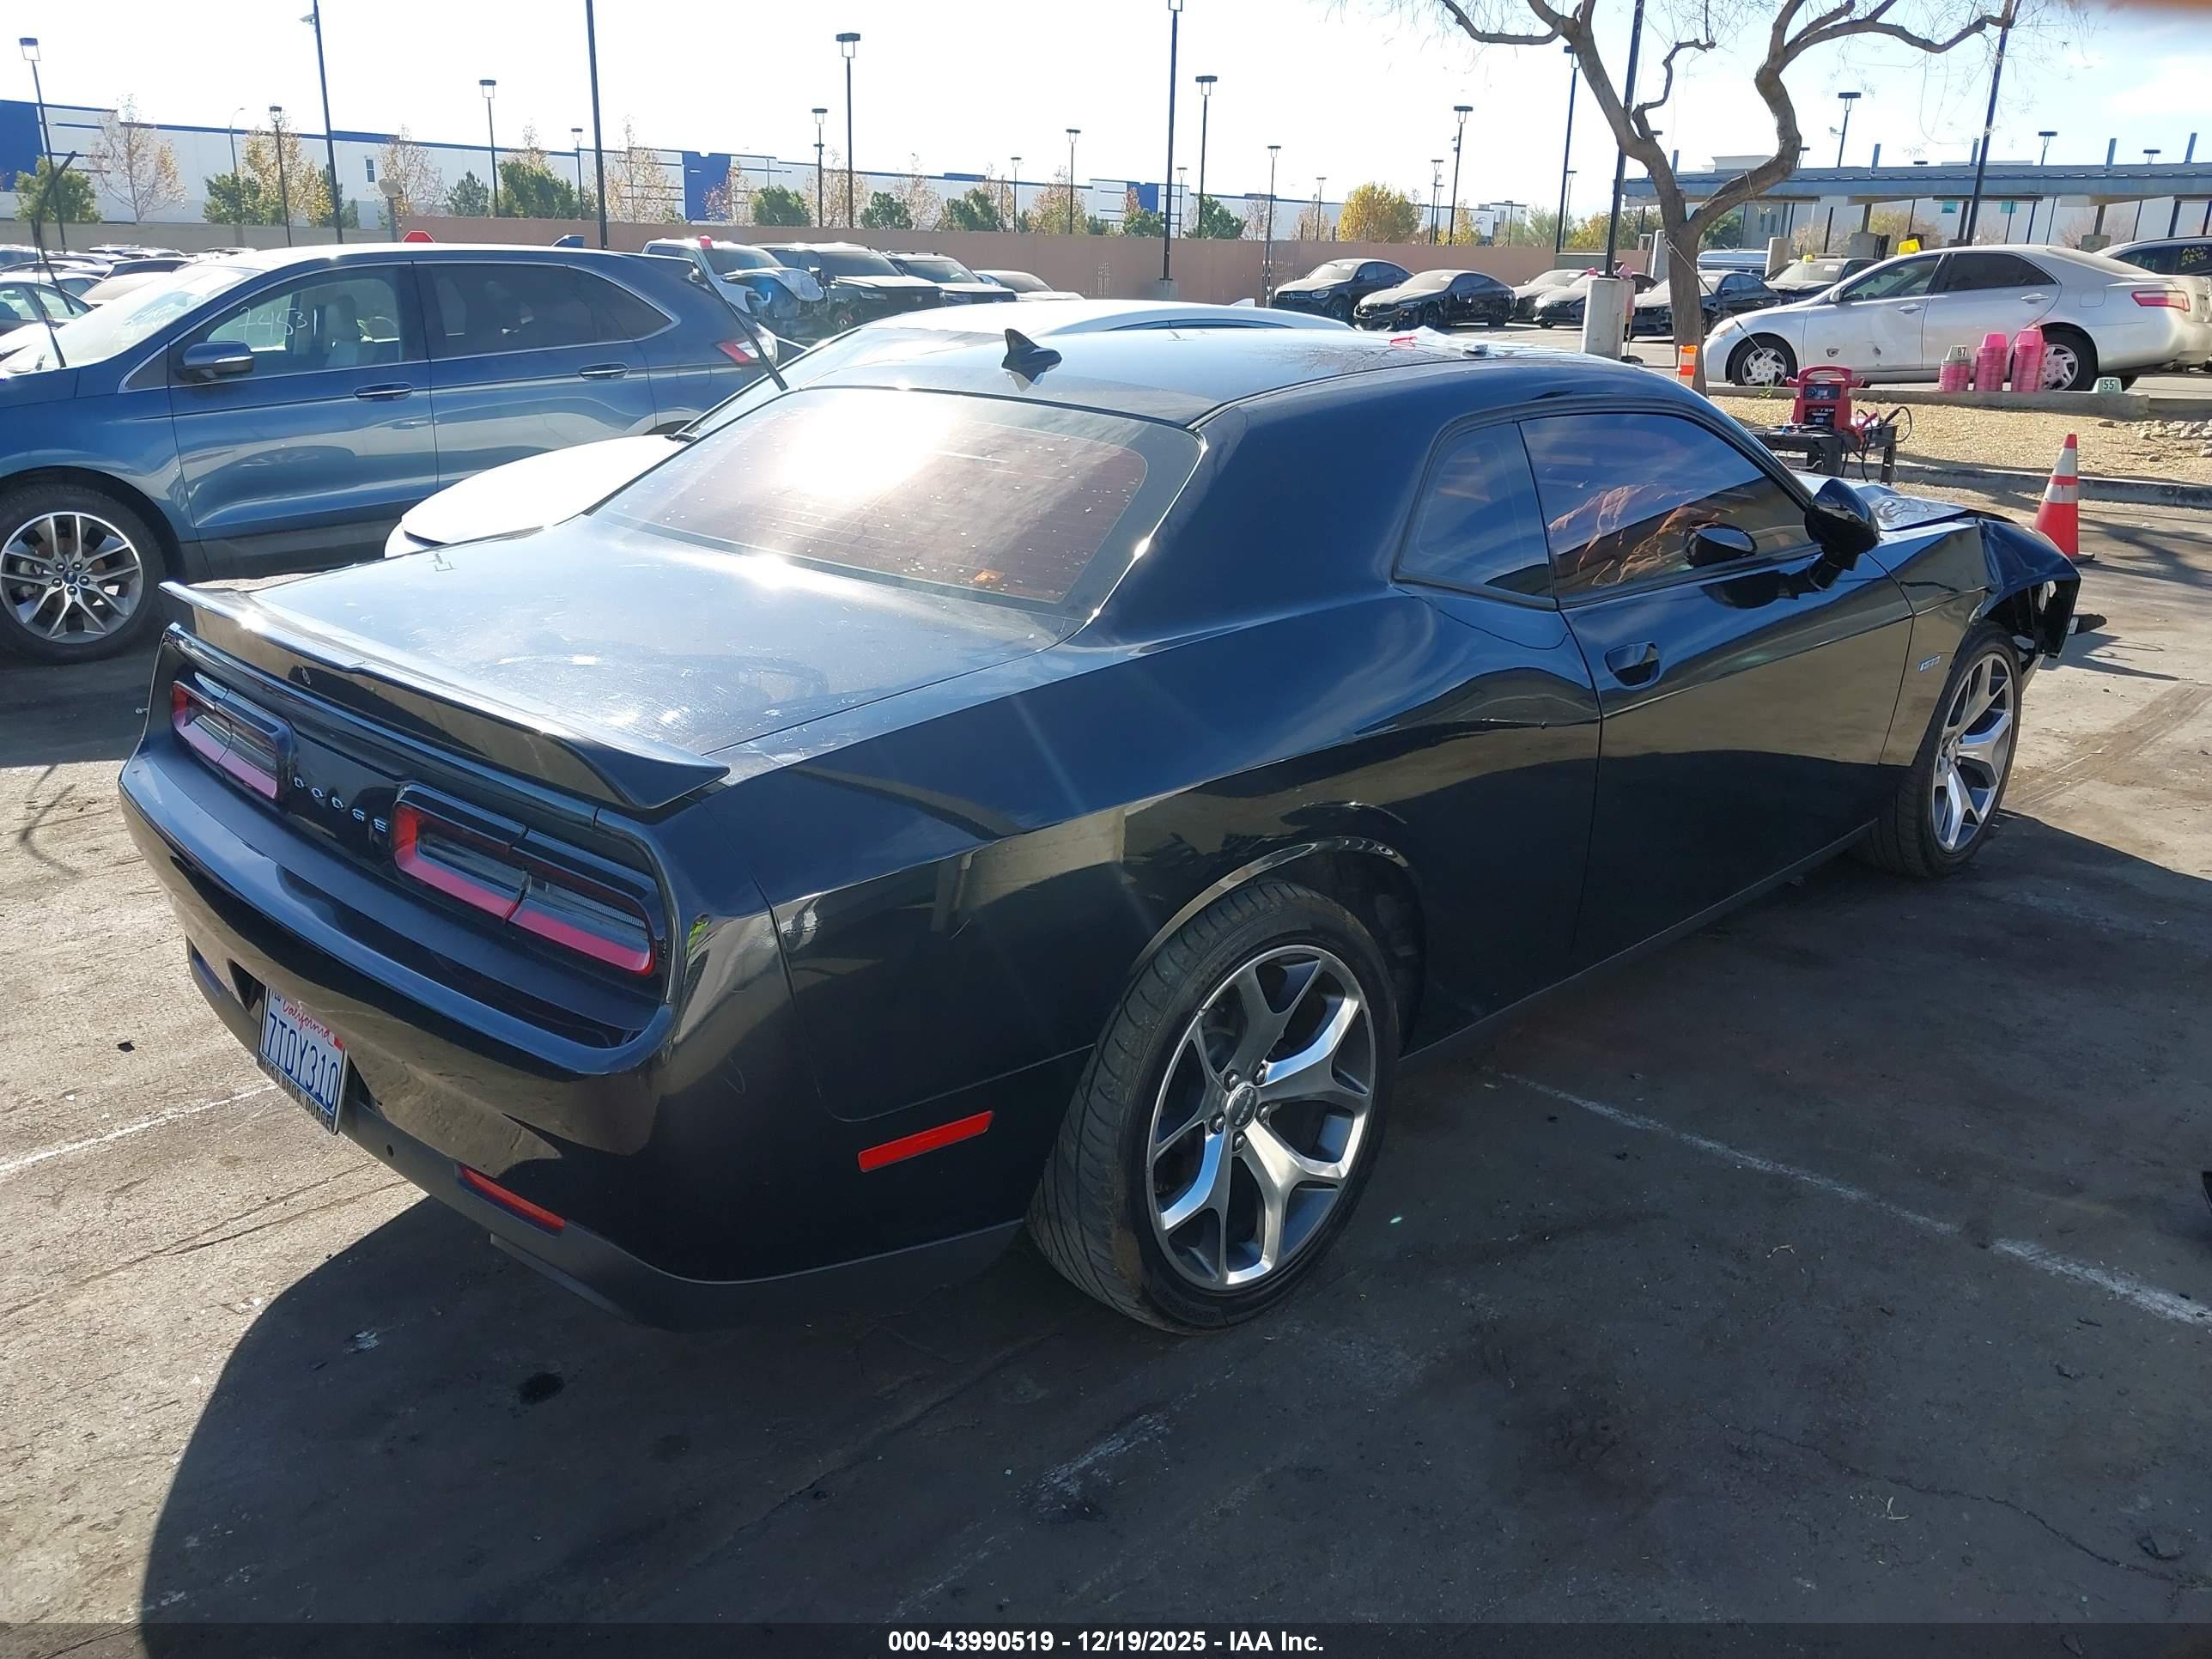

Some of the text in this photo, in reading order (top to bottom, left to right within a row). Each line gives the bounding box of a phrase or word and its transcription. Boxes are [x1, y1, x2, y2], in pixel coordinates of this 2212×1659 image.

[238, 307, 318, 340] 74531
[2103, 379, 2116, 390] 55
[294, 776, 387, 833] DODGE
[282, 999, 334, 1047] California
[261, 1057, 279, 1084] MOSS
[306, 1097, 332, 1128] DODGE
